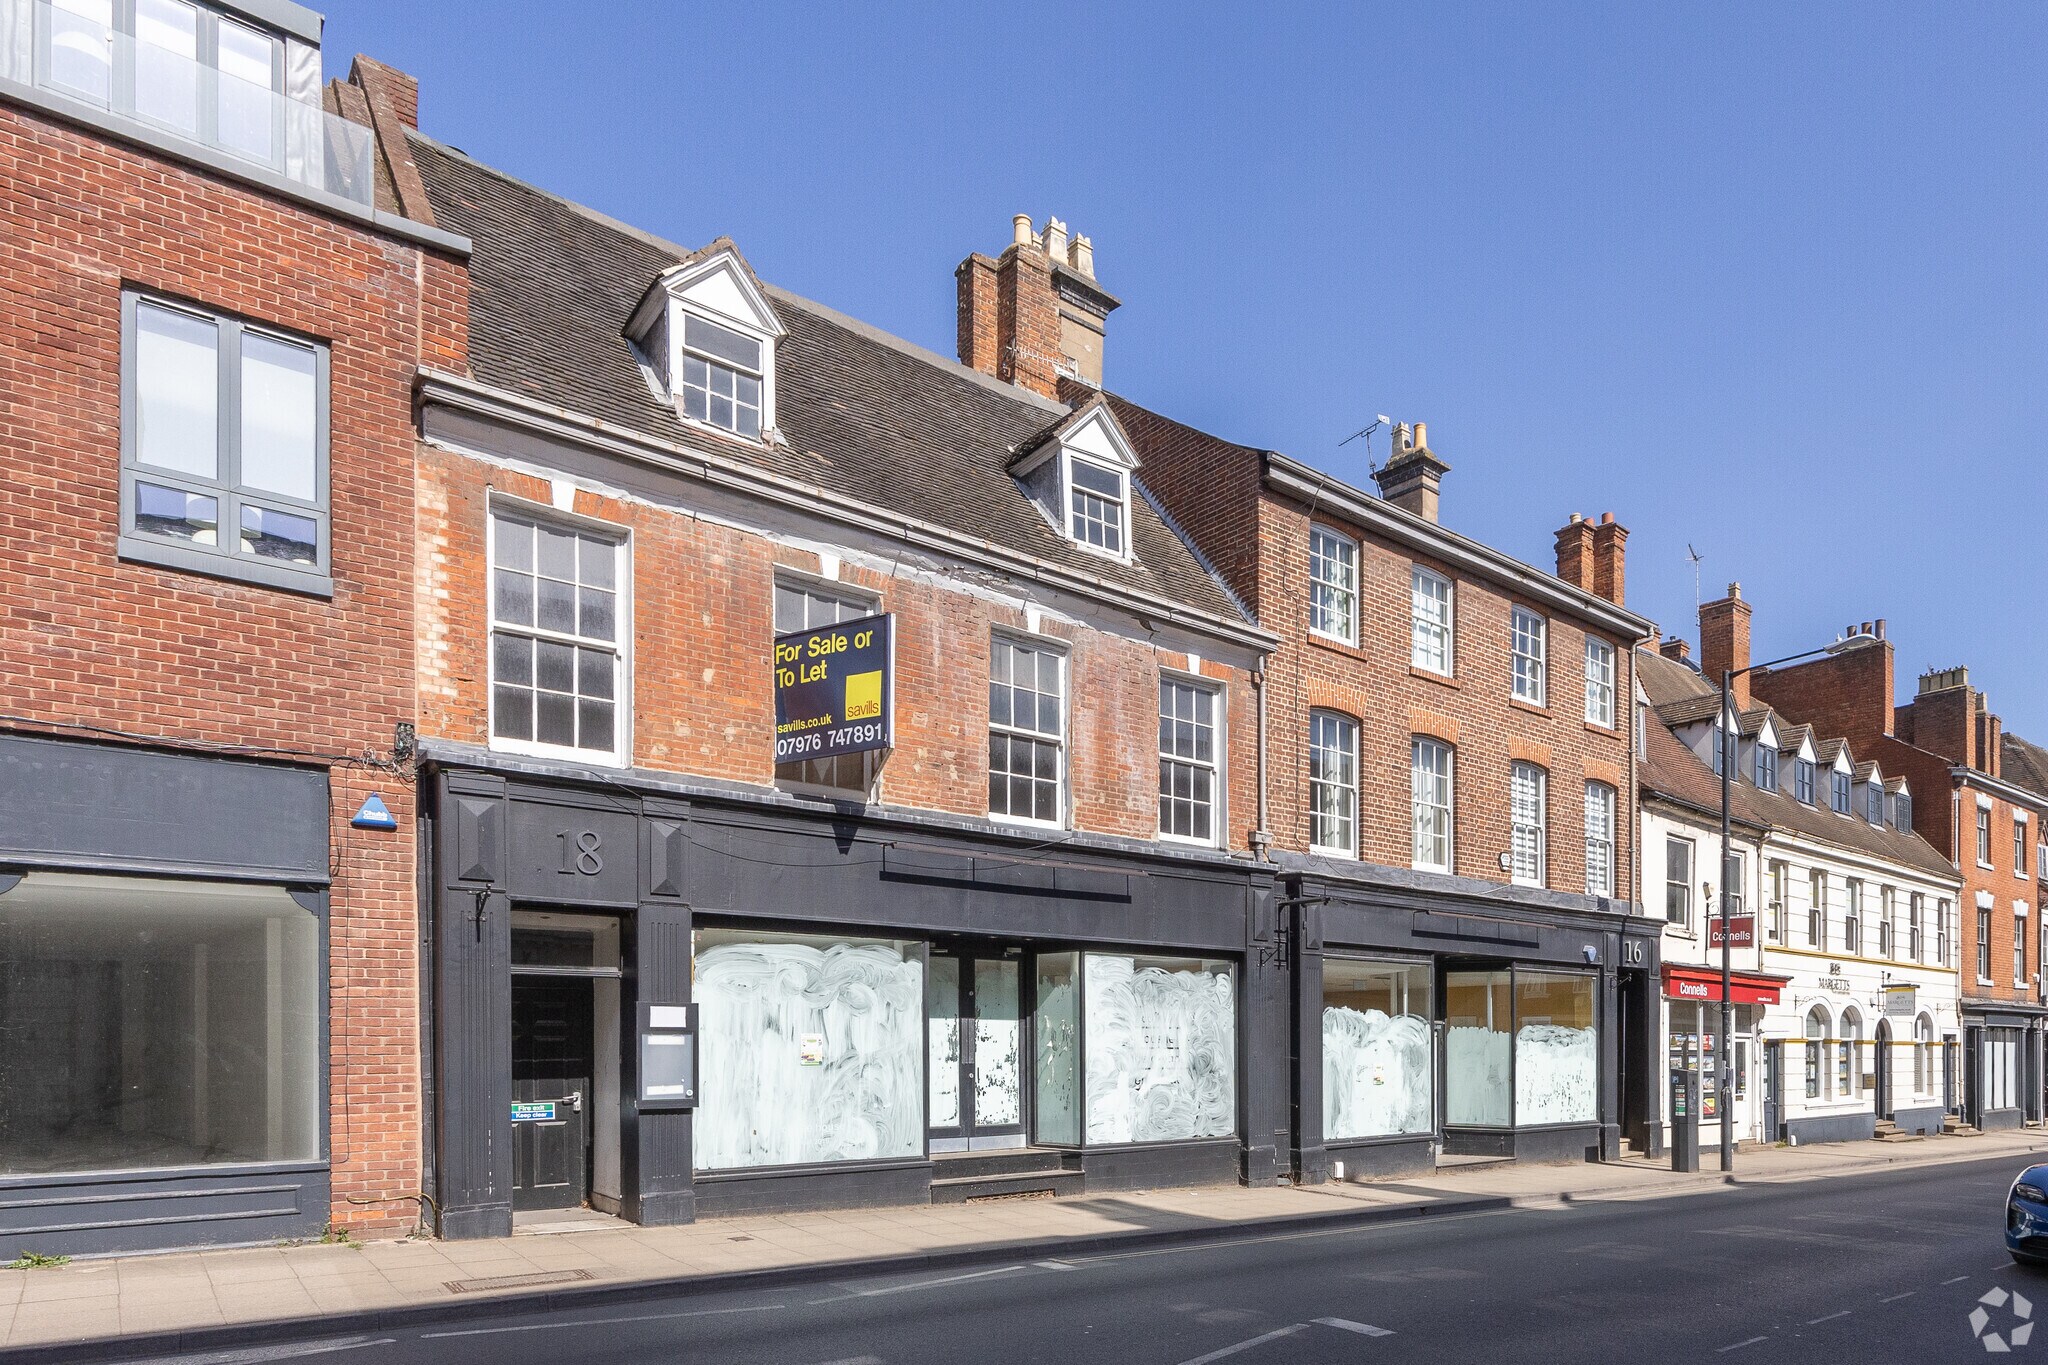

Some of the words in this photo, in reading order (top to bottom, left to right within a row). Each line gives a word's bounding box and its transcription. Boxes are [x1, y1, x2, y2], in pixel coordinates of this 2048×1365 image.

[775, 643, 802, 665] For
[807, 632, 848, 658] Sale
[854, 630, 873, 649] or
[776, 668, 795, 689] To
[800, 659, 827, 684] Let
[847, 700, 879, 717] savills
[777, 713, 832, 734] savills.co.uk
[777, 733, 821, 756] 07976
[828, 723, 881, 748] 747891
[556, 829, 604, 876] 18
[1712, 930, 1751, 941] Conells
[1624, 940, 1642, 964] 16
[1680, 982, 1708, 996] Connells
[1818, 977, 1850, 991] MARGETTS
